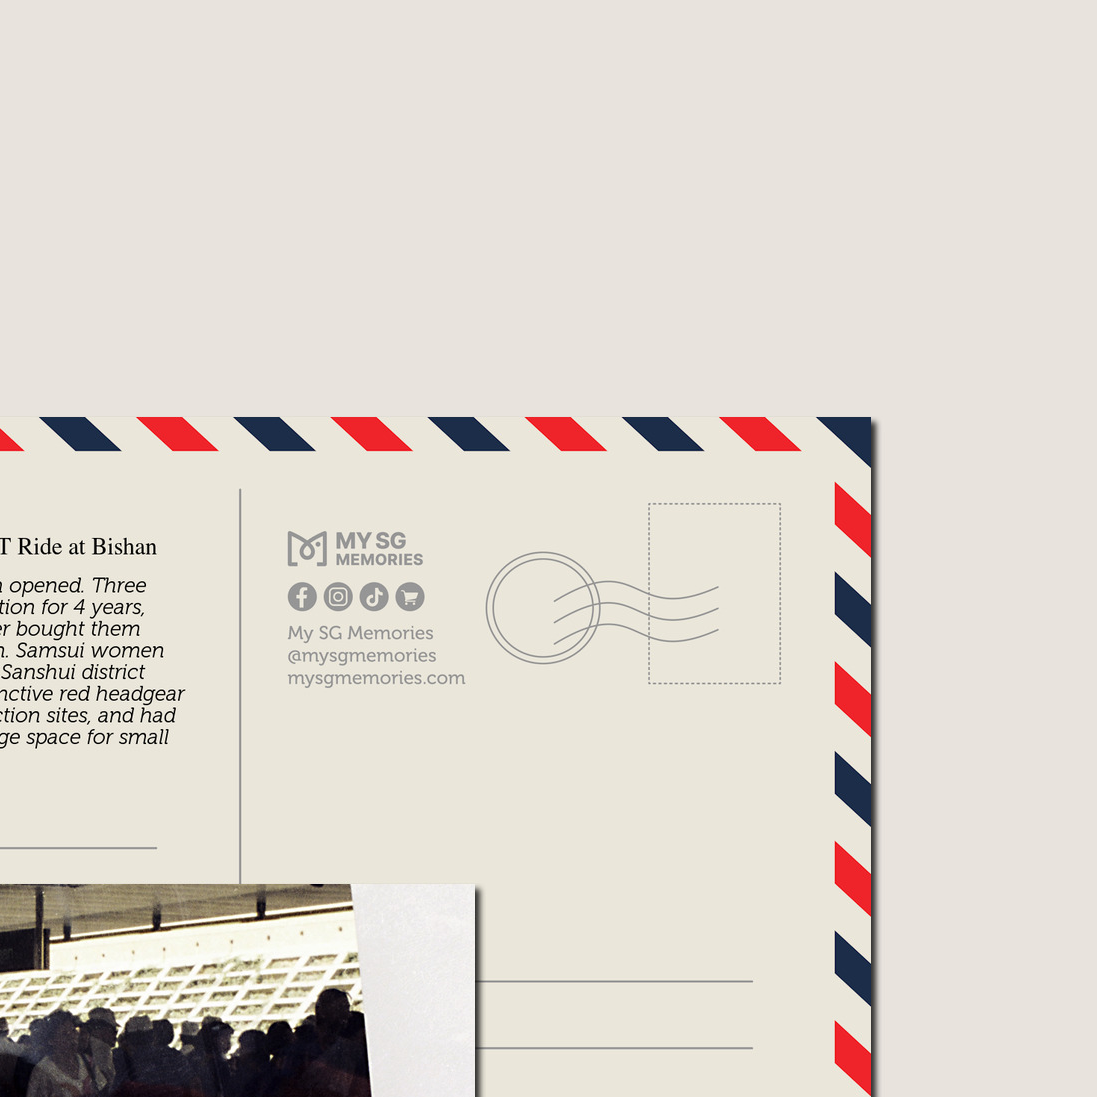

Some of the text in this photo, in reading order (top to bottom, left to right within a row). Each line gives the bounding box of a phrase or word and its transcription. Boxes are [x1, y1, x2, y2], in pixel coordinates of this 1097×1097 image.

[18, 538, 62, 555] Ride
[69, 540, 86, 555] at
[92, 537, 157, 555] Bishan
[336, 532, 406, 549] MY SG
[336, 554, 423, 565] MEMORIES
[10, 577, 83, 597] opened.
[93, 577, 146, 593] Three
[42, 599, 68, 614] for
[73, 599, 85, 614] 4
[90, 603, 144, 619] years,
[16, 620, 85, 641] bought
[92, 620, 140, 636] them
[288, 626, 433, 643] My SG Memories
[16, 642, 85, 658] Samsui
[91, 646, 164, 658] women
[288, 648, 436, 666] @mysgmemories
[1, 664, 76, 679] Sanshui
[82, 664, 146, 679] district
[288, 671, 465, 688] mysgmemories.com
[60, 685, 90, 701] red
[96, 685, 186, 705] headgear
[46, 707, 90, 725] sites,
[98, 707, 134, 723] and
[140, 707, 176, 723] had
[26, 732, 81, 749] space
[87, 729, 114, 744] for
[119, 729, 169, 744] small
